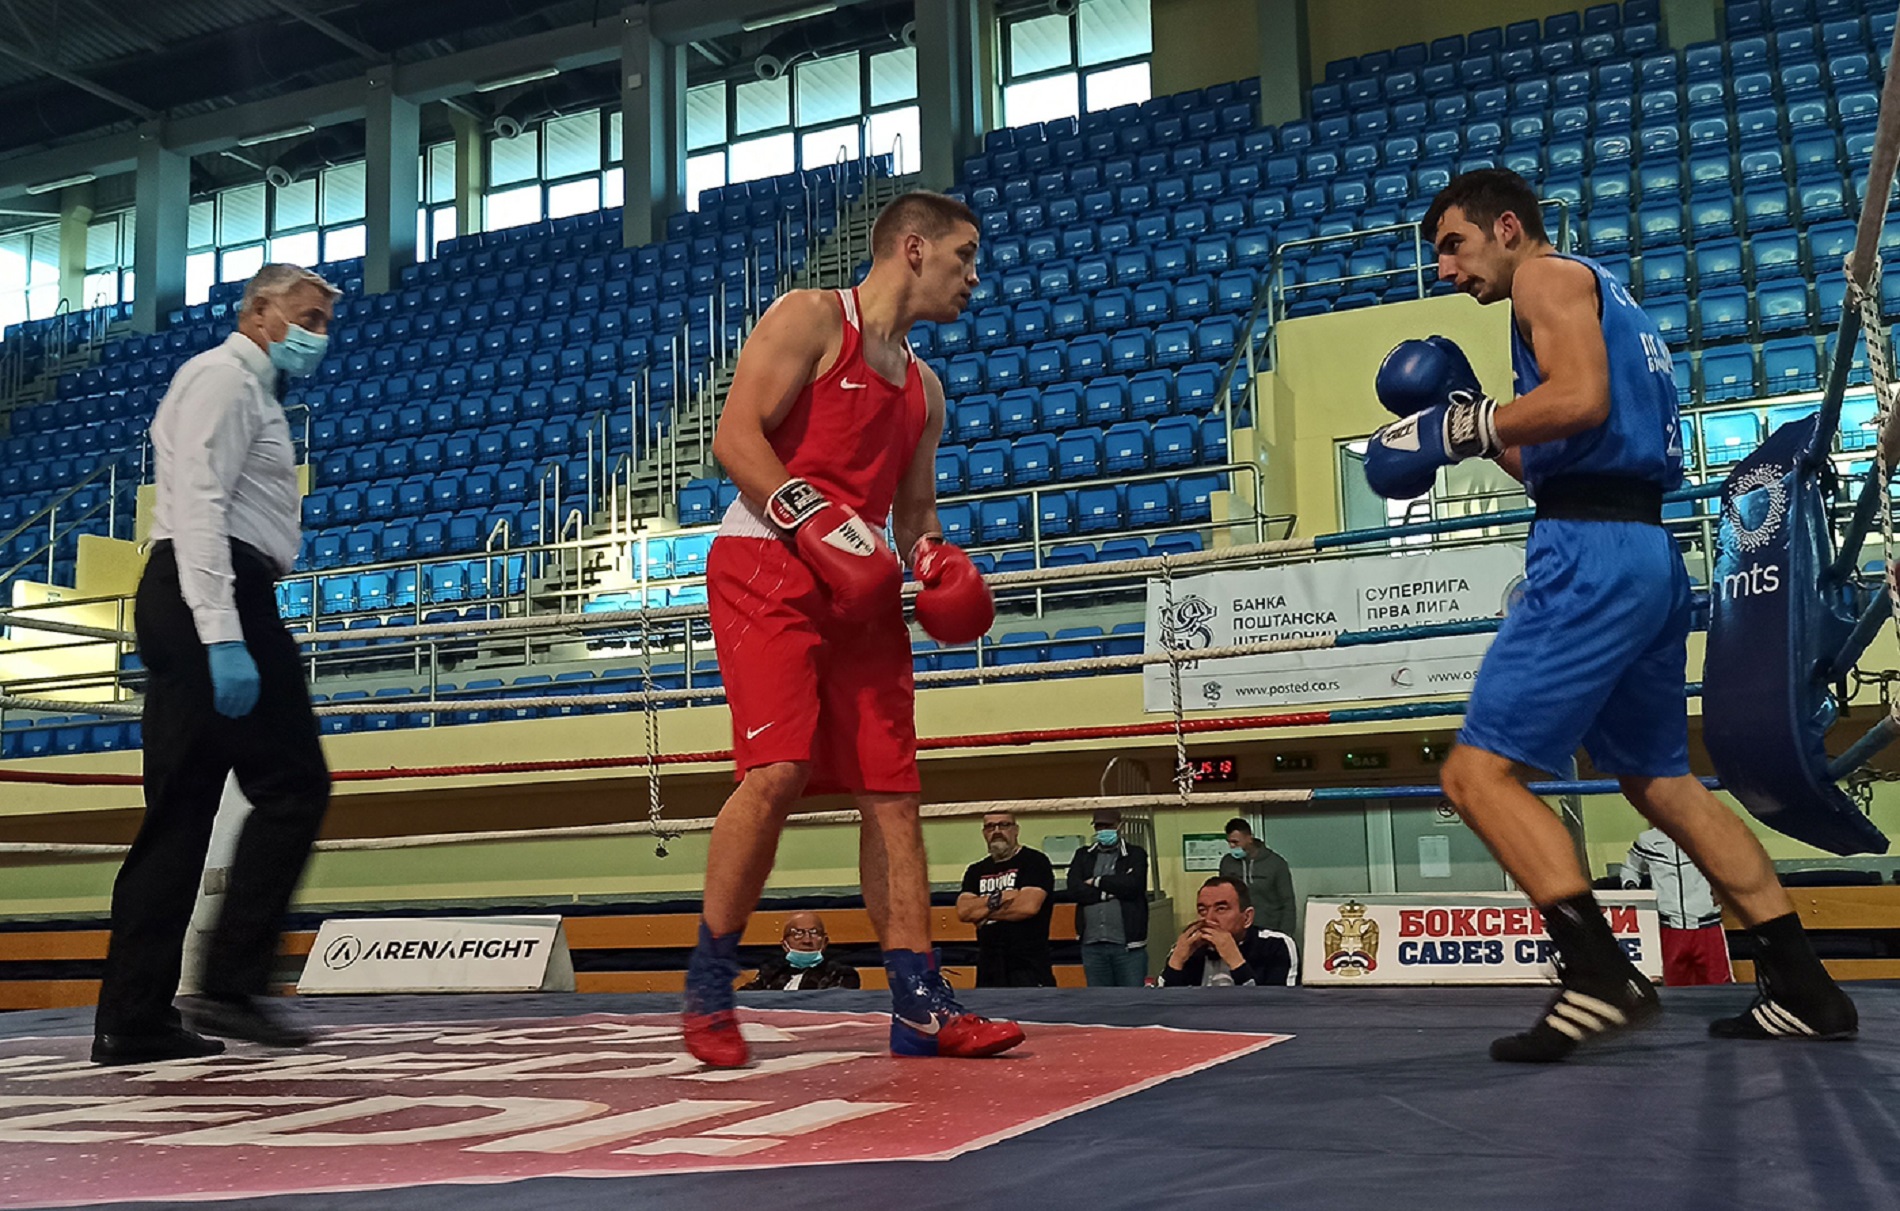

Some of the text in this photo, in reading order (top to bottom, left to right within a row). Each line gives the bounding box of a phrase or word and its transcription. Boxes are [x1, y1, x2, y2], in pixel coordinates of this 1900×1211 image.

[1365, 578, 1470, 602] СУПЕРЛИГА
[1721, 562, 1779, 599] mts
[1233, 595, 1287, 613] БАНКА
[1367, 599, 1460, 620] ПРВА ЛИГА
[1233, 612, 1338, 630] ПОШТАНСКА
[1235, 680, 1340, 697] www.posted.co.rs
[1398, 906, 1640, 937] БОКСЕРИ
[1398, 940, 1505, 965] САВЕЗ
